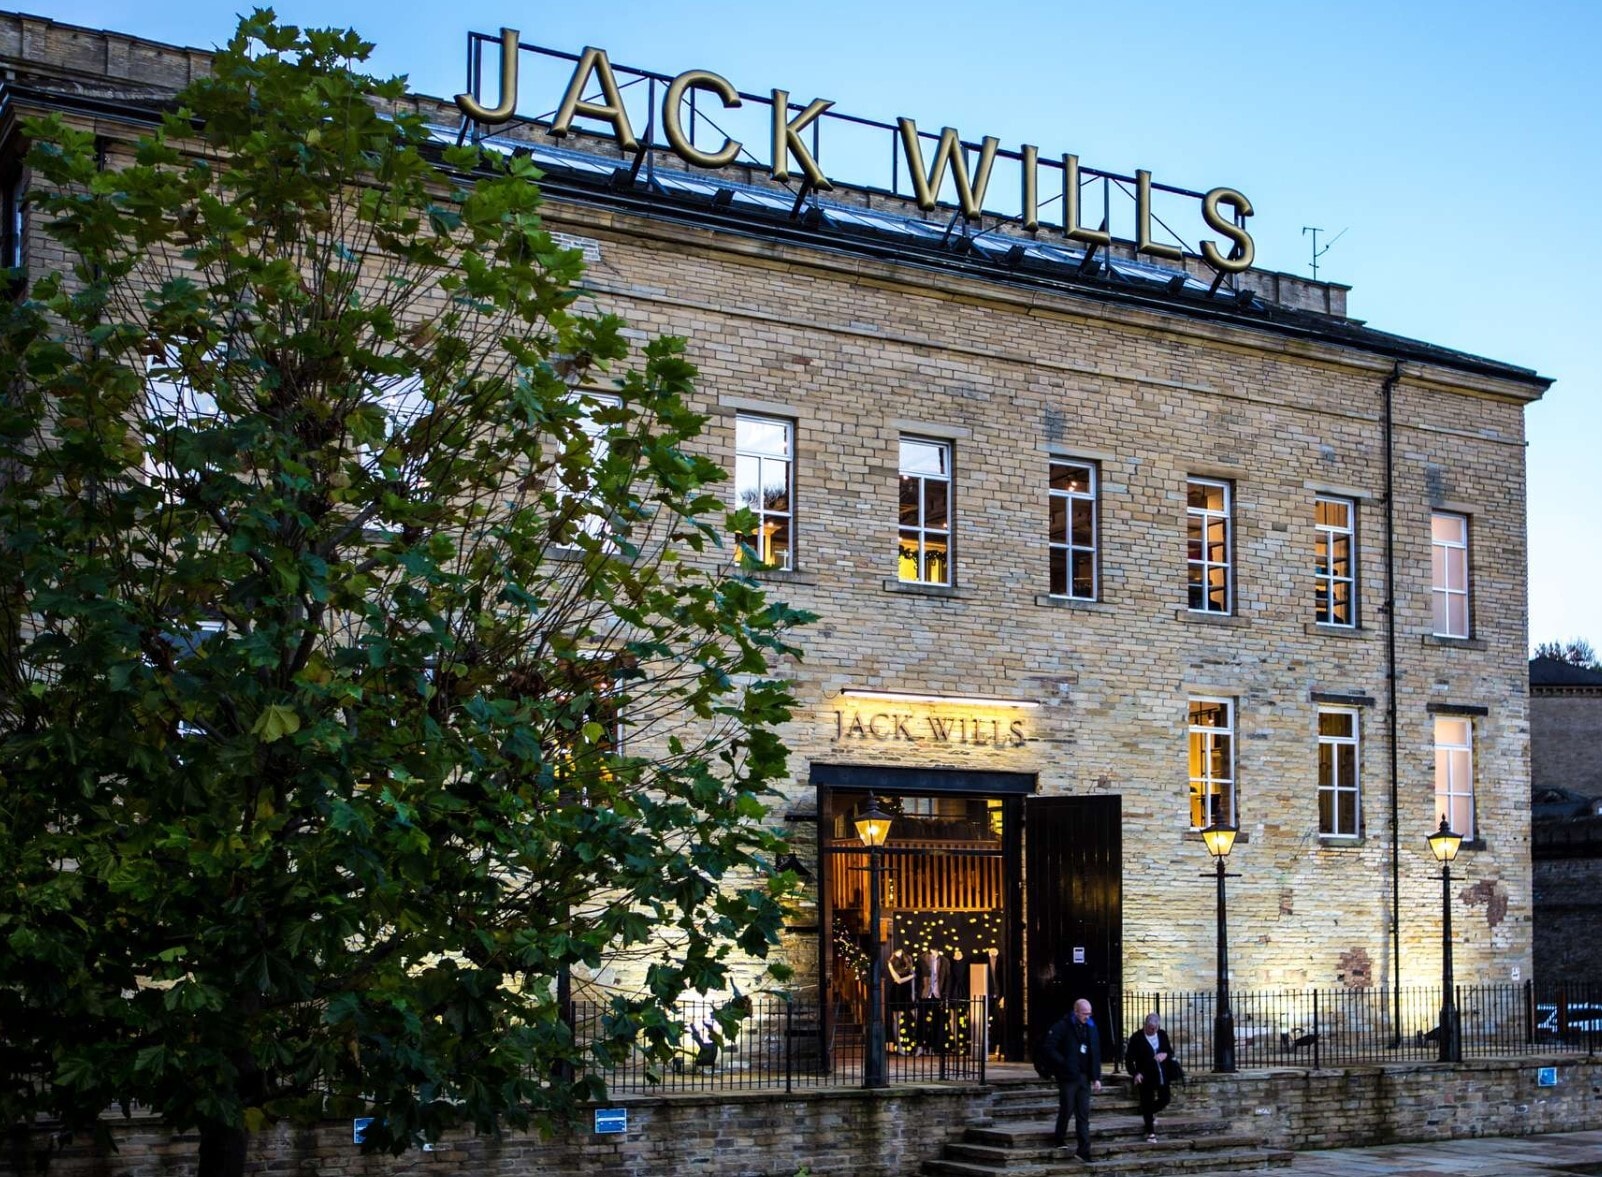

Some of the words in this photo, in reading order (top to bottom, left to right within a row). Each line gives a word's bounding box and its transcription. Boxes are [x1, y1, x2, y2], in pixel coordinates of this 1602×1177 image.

[454, 26, 835, 190] JACK
[896, 116, 1255, 273] WILLS
[831, 710, 913, 742] JACK
[928, 716, 1025, 746] WILLS
